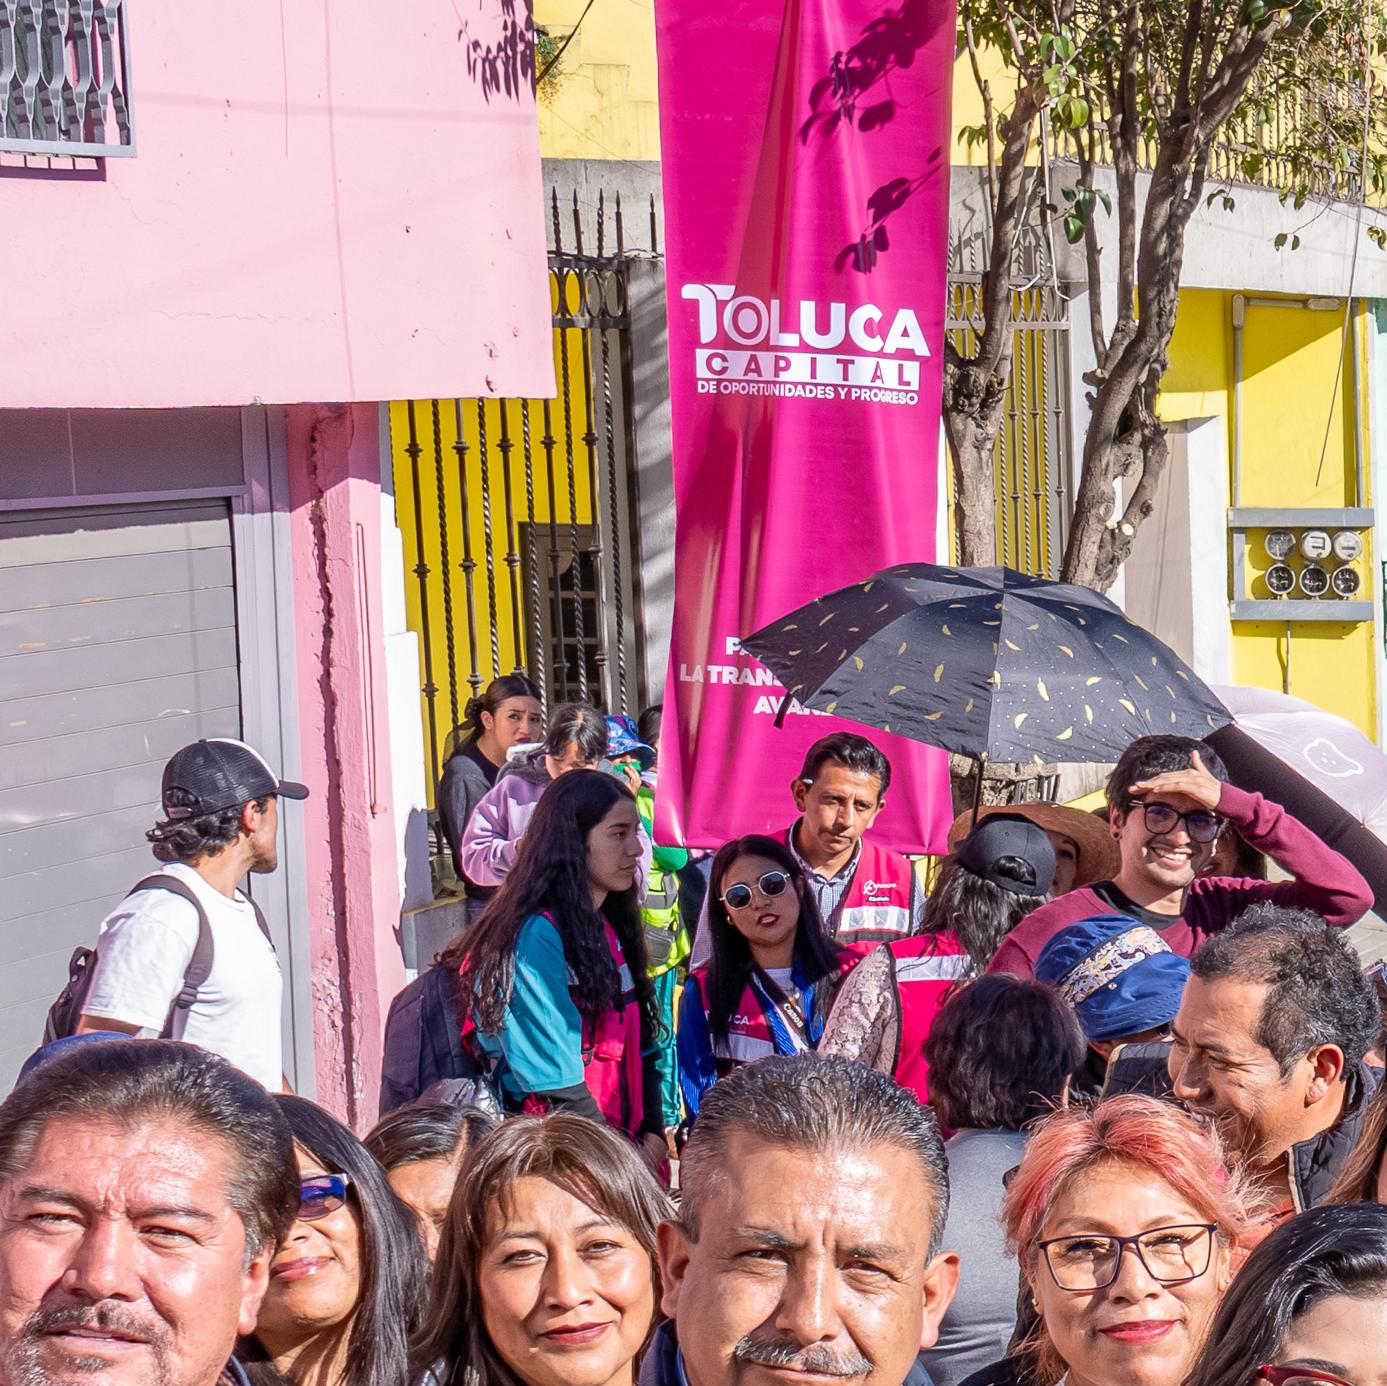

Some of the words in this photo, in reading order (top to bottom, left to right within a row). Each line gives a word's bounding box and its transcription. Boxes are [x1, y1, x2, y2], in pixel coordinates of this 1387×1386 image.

[681, 284, 931, 357] TOLUCA
[705, 351, 912, 387] CAPITAL
[697, 380, 717, 394] DE
[720, 381, 834, 400] OPORTUNIDADES
[838, 387, 847, 400] Y
[680, 663, 704, 682] LA
